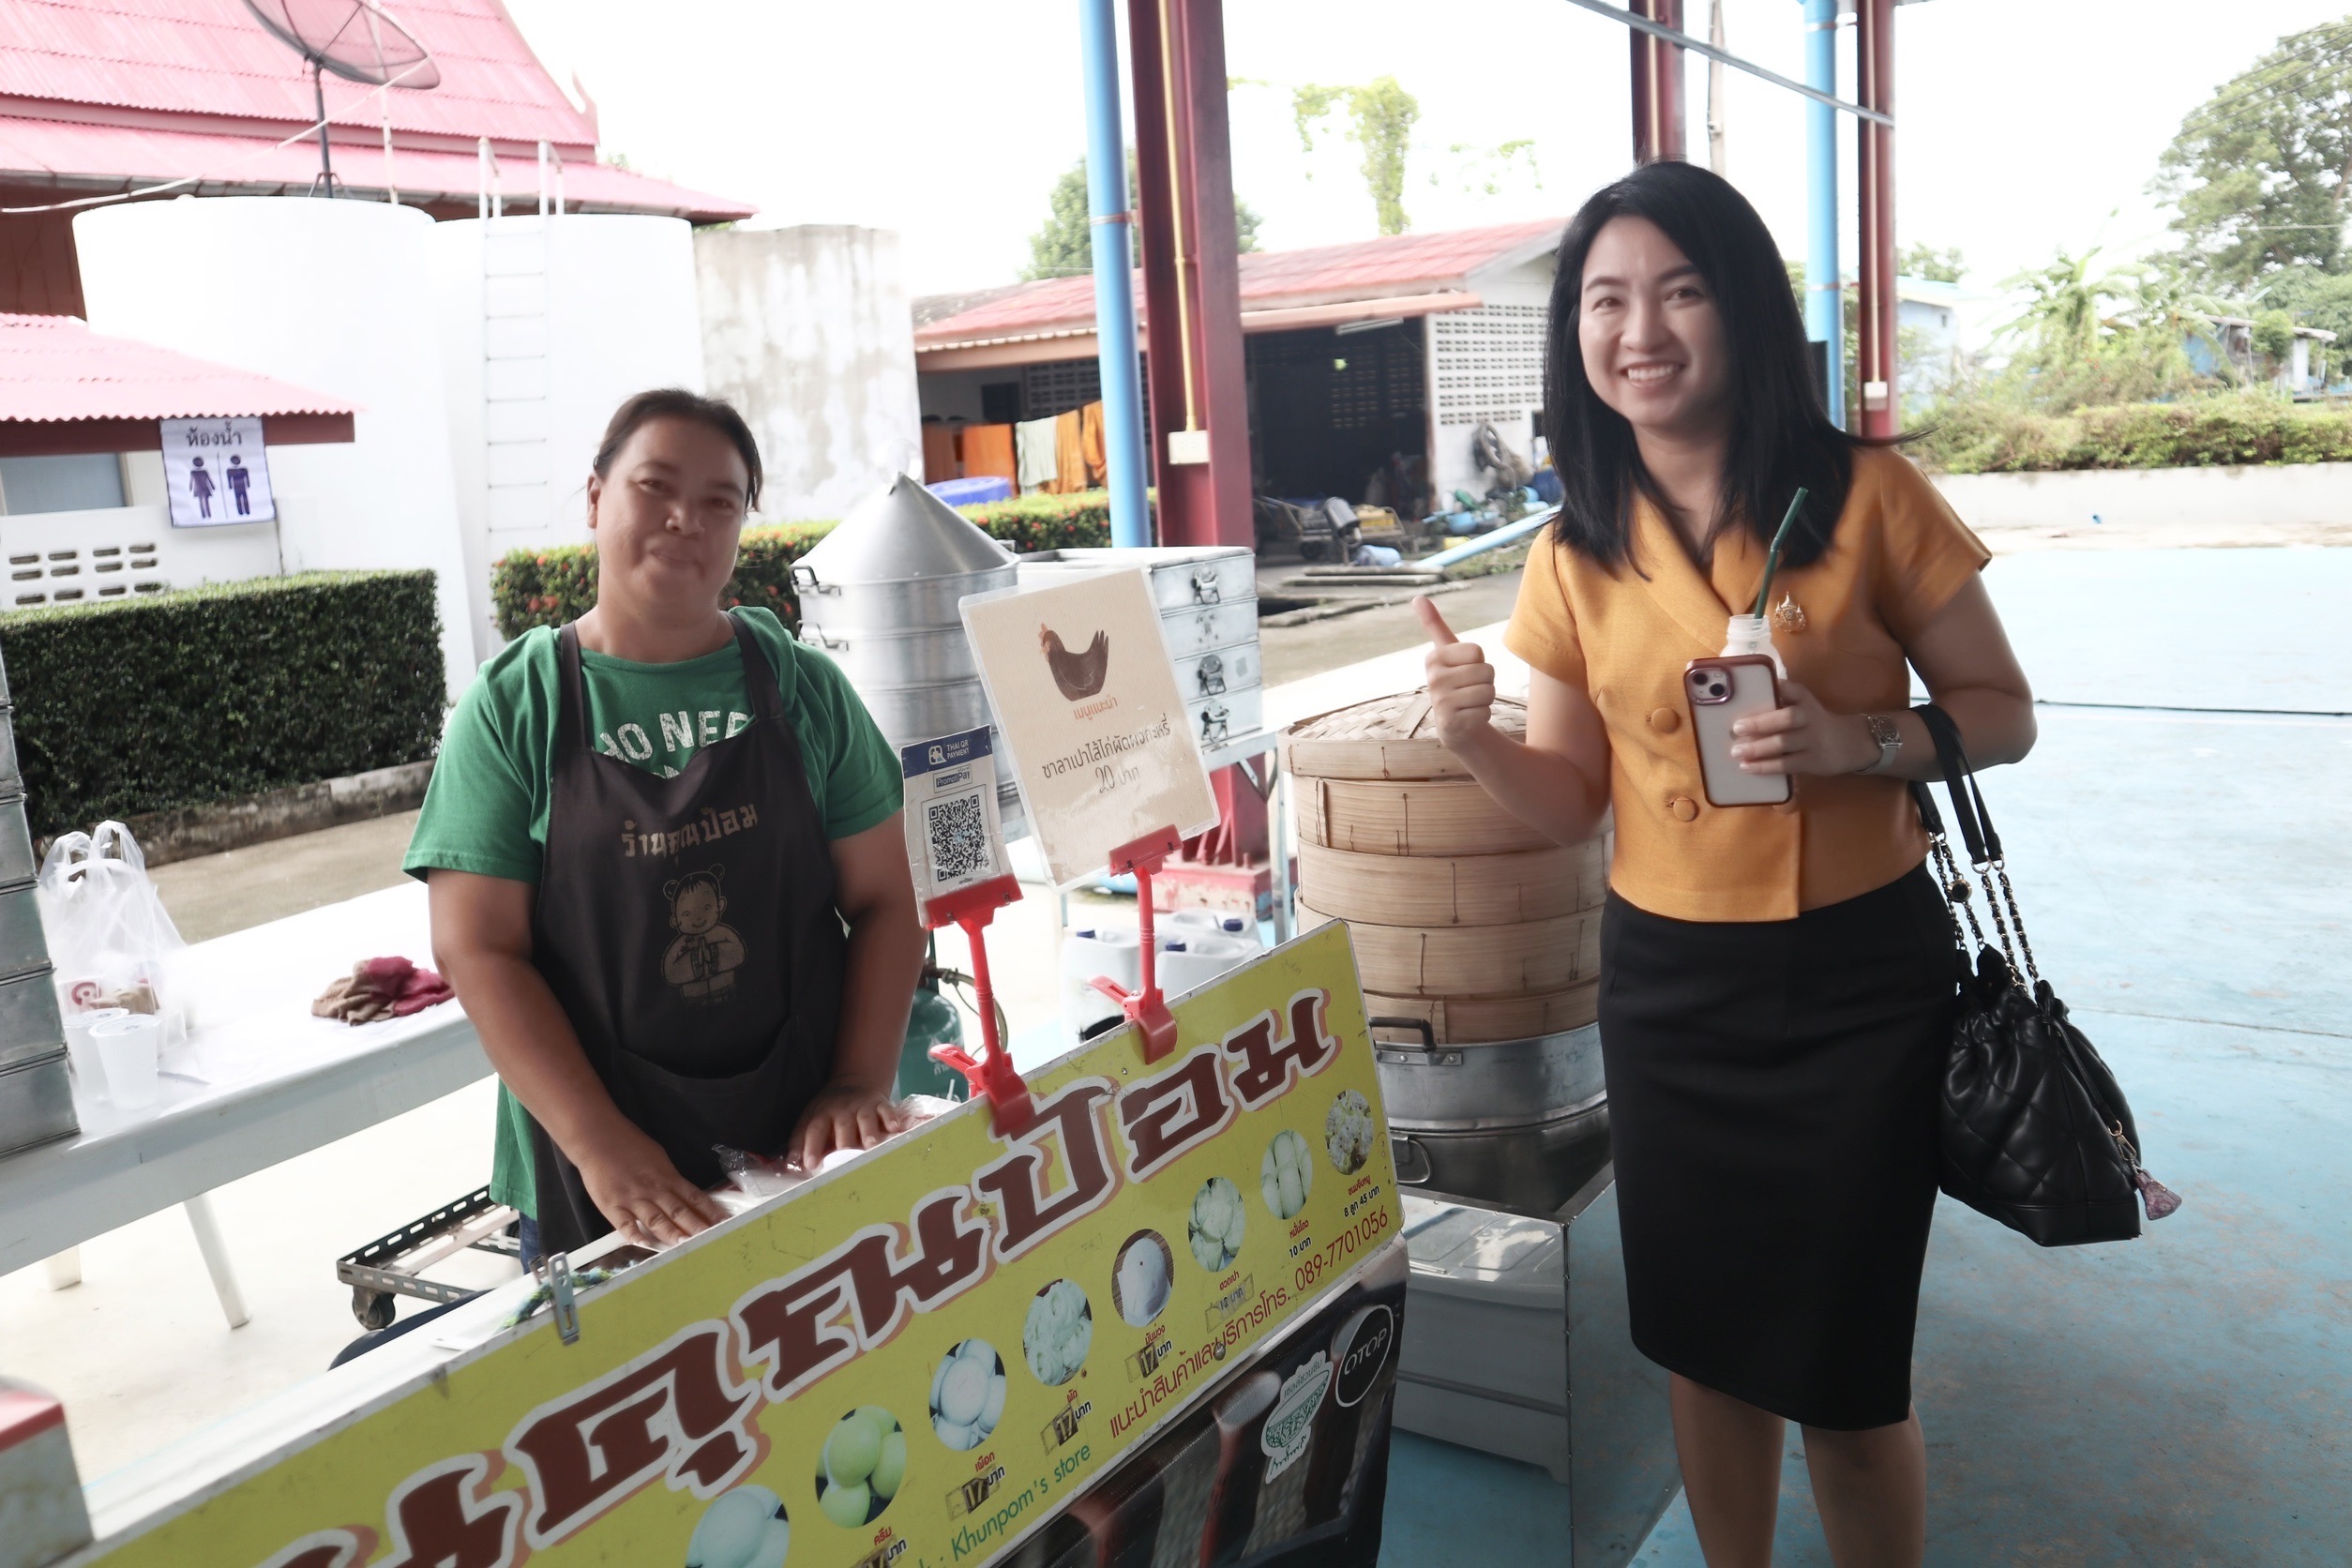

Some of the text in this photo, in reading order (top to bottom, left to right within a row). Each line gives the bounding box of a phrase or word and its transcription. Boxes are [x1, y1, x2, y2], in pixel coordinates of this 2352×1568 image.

[185, 421, 242, 447] ห้องน้ำ
[1073, 693, 1119, 721] เมนูแนะนำ
[946, 739, 970, 752] THAI QR
[946, 747, 971, 760] PAYMENT
[1094, 764, 1141, 794] 20 บาท
[621, 804, 758, 867] ร้านคุณป้อม
[1344, 1185, 1380, 1217] 8 ลูก 45 บาท
[1289, 1236, 1312, 1259] 10 บาท
[1294, 1204, 1388, 1292] 089-7701056
[1230, 1287, 1244, 1303] บาท
[1139, 1339, 1172, 1376] 17 บาท
[1343, 1327, 1387, 1376] OTOP
[1067, 1388, 1078, 1403] ผัก
[1055, 1400, 1092, 1442] 17 บาท
[974, 1451, 996, 1472] เผือก
[964, 1465, 1005, 1511] 17 บาท
[951, 1444, 1092, 1562] Khunpom's store
[874, 1526, 892, 1546] ครีม
[886, 1539, 907, 1561] บาท
